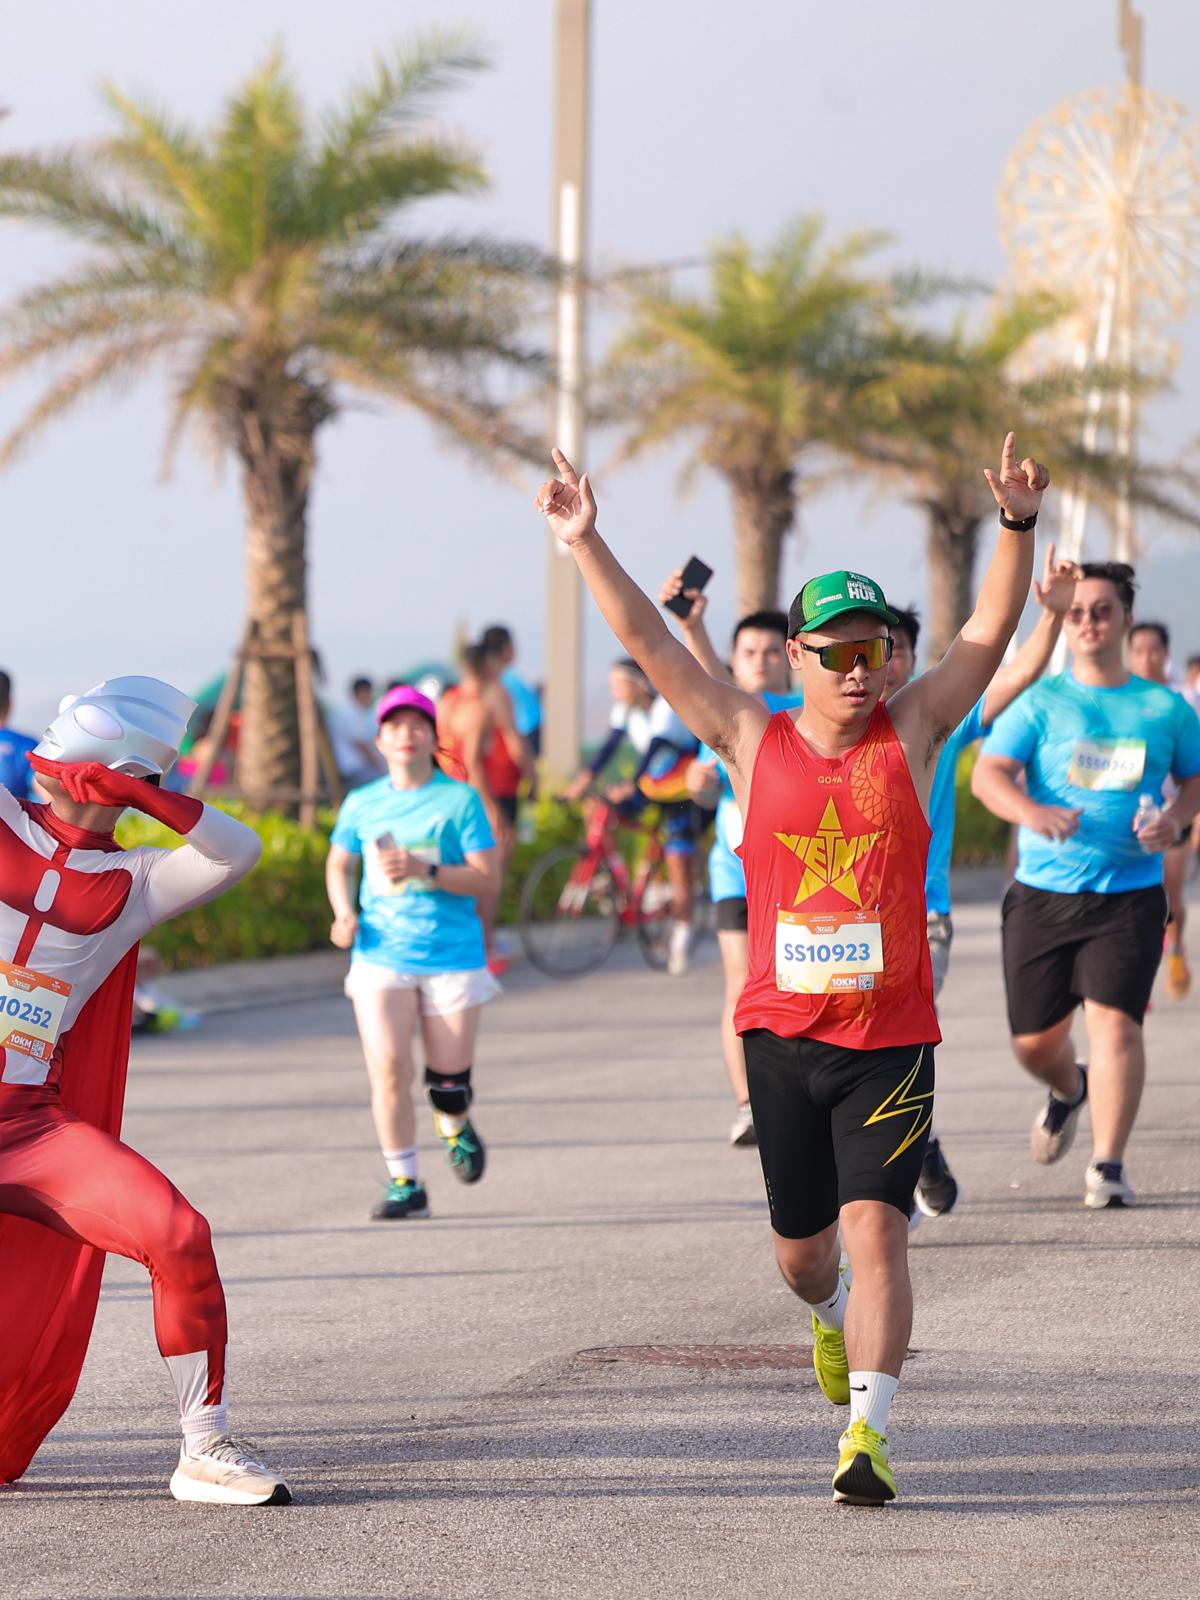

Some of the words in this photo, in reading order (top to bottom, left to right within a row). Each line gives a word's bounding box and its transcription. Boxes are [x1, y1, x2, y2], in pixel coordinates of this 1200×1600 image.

[784, 943, 871, 963] SS10923
[831, 977, 857, 986] 10KM
[10, 1033, 32, 1048] 10KM
